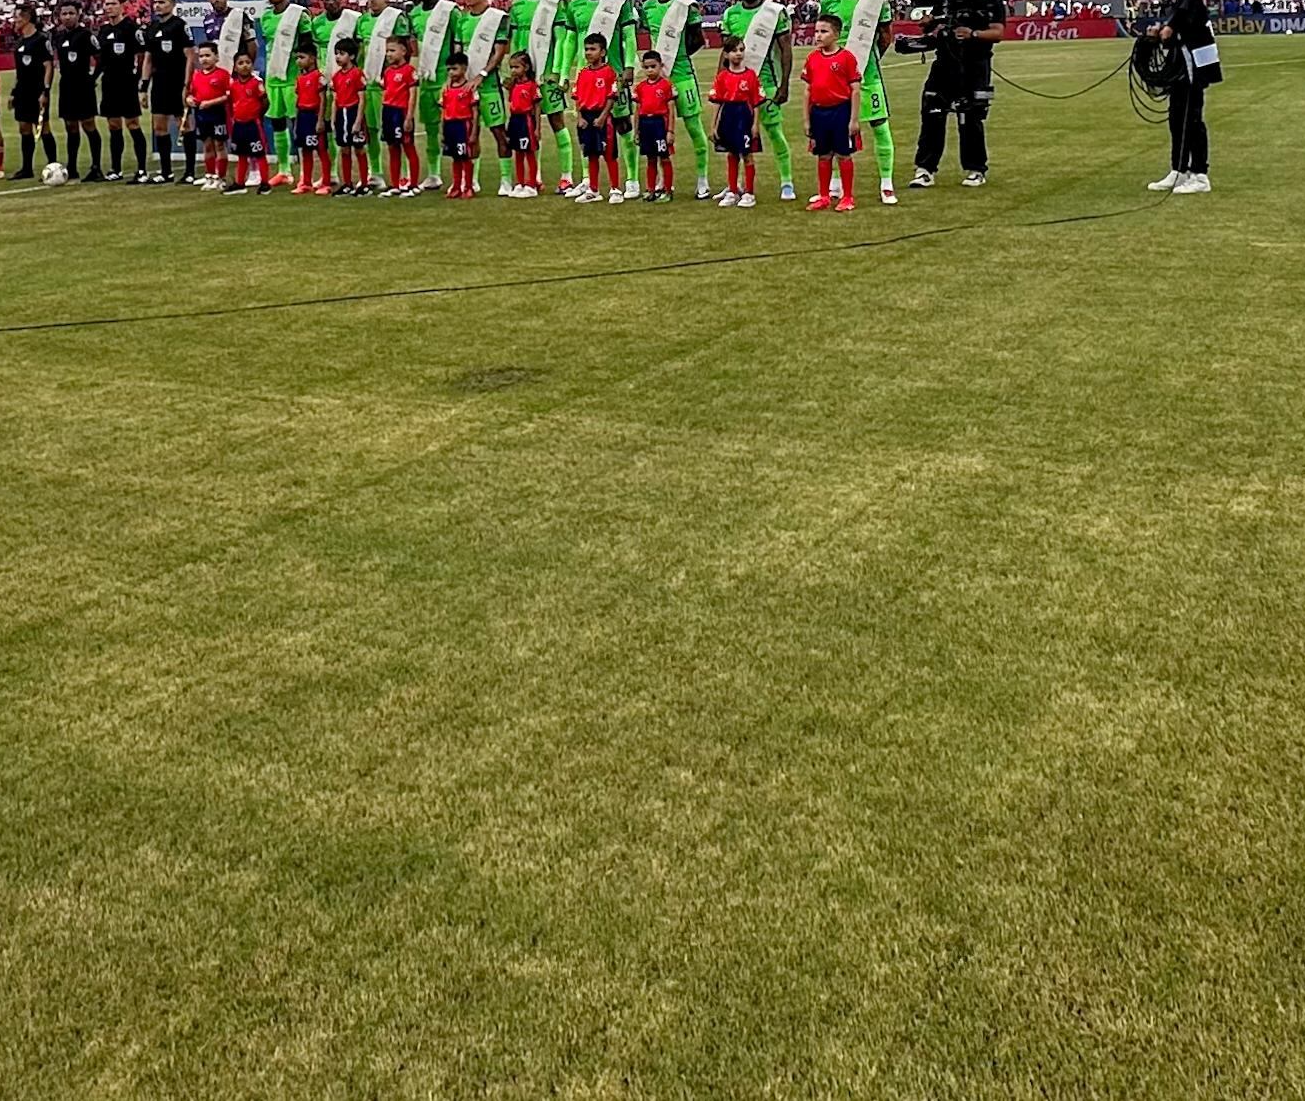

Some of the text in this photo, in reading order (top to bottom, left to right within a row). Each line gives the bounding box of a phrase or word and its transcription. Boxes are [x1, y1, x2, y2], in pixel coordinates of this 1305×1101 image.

[1016, 20, 1080, 40] Pilsen
[1212, 14, 1265, 34] etPlay
[686, 90, 695, 104] 11
[870, 93, 880, 109] 8
[250, 140, 263, 152] 26
